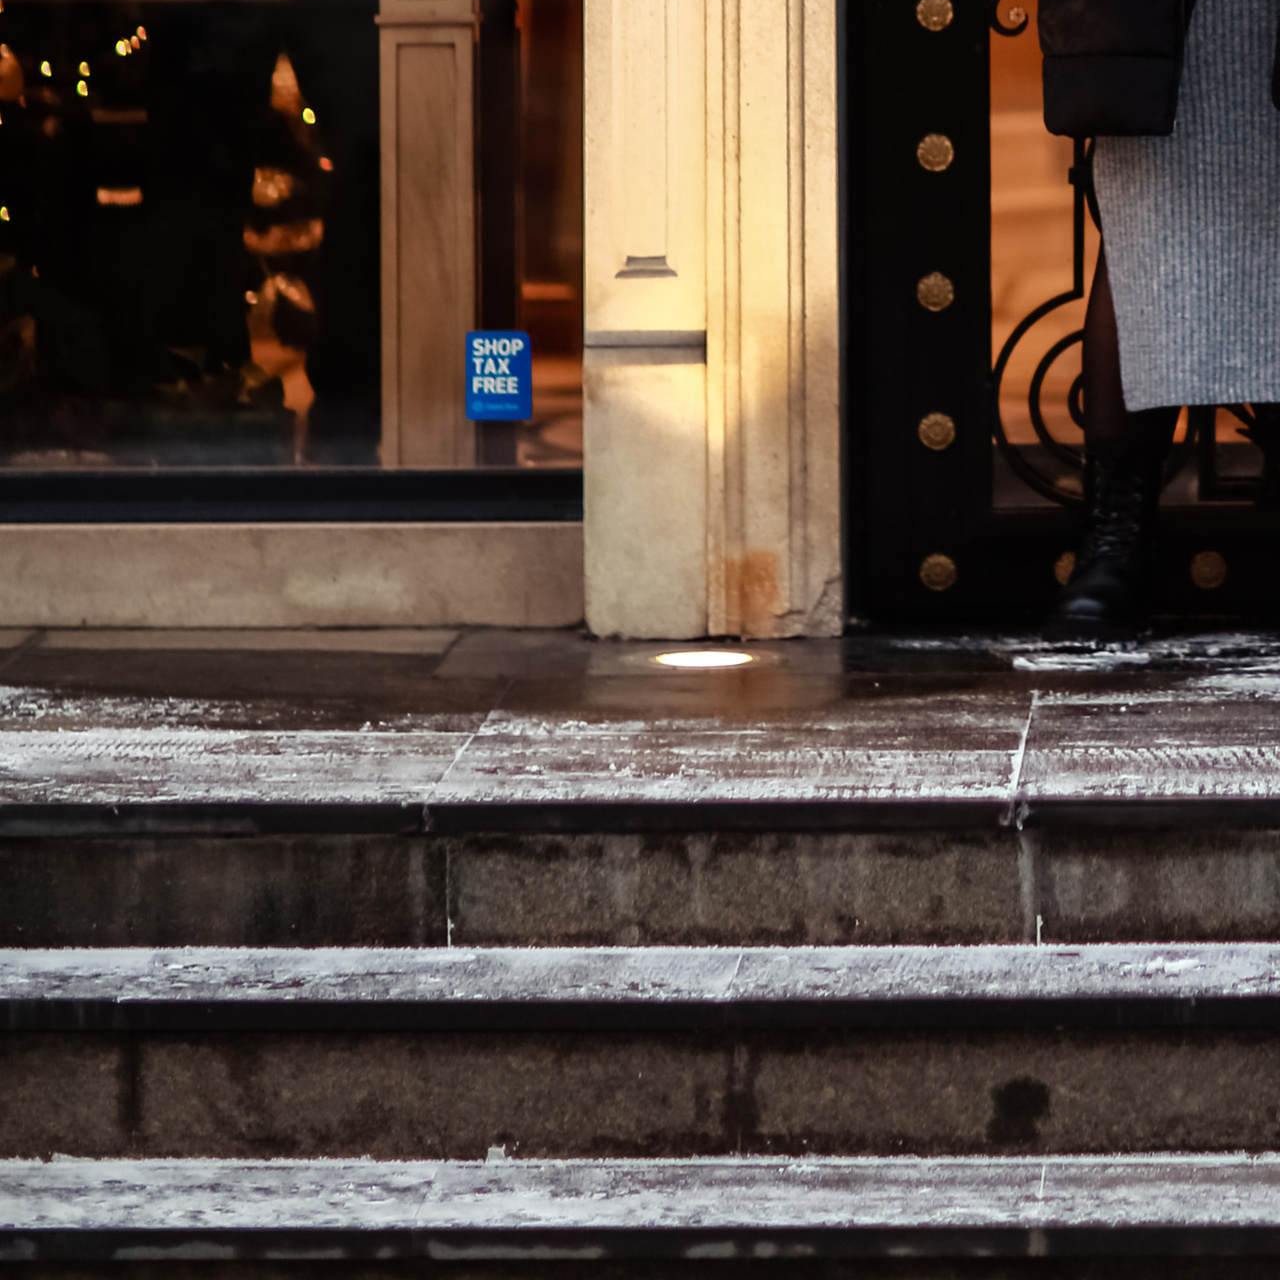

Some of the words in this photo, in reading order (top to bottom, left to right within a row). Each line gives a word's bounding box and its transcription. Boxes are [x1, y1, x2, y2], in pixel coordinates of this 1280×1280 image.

[472, 338, 524, 356] SHOP
[472, 357, 510, 375] TAX
[472, 376, 519, 394] FREE
